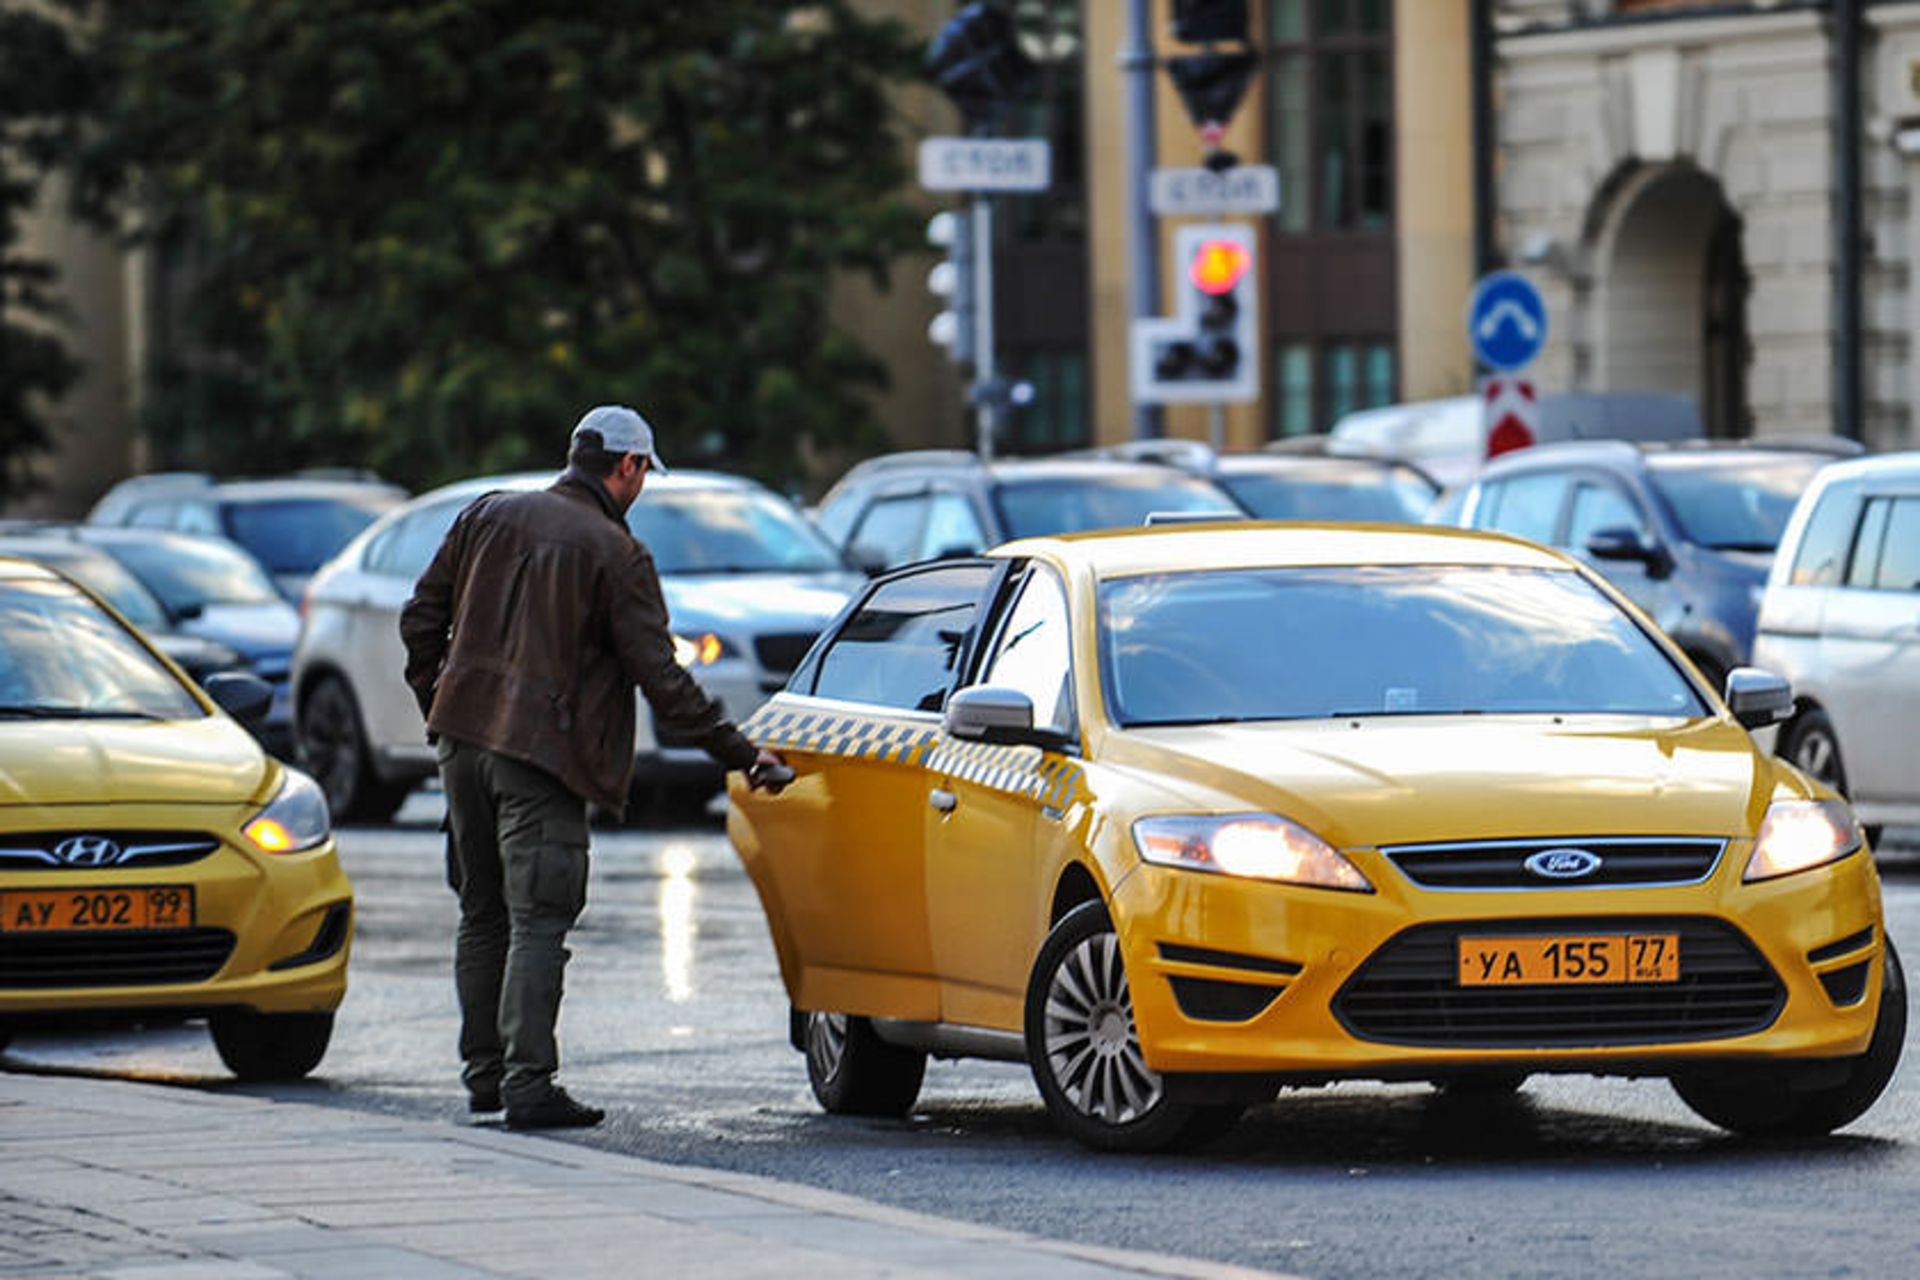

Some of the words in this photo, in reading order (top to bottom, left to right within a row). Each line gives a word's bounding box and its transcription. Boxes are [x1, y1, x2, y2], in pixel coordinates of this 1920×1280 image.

[72, 894, 132, 925] 202
[150, 891, 182, 915] 99
[1543, 942, 1610, 978] 155
[1632, 940, 1666, 966] 77
